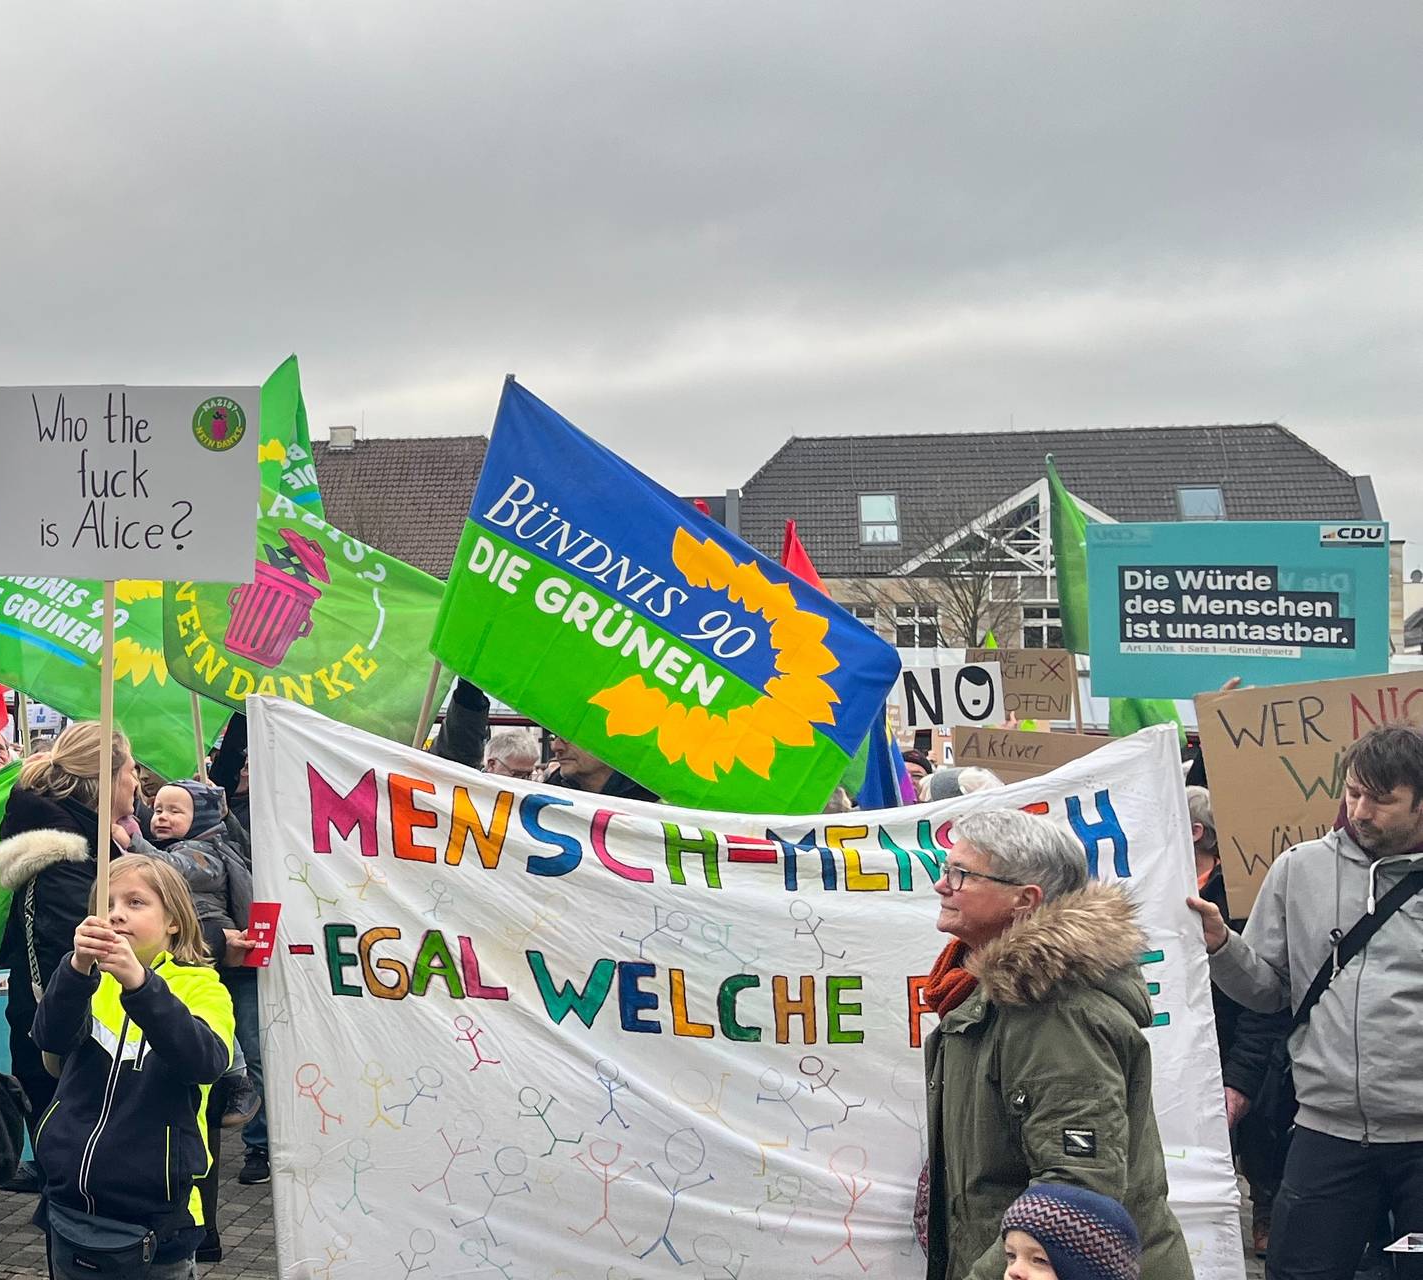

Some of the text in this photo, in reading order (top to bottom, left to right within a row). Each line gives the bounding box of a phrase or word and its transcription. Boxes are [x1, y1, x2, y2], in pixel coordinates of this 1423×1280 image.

[32, 392, 152, 443] Who the
[202, 398, 238, 412] NAZIS?
[196, 426, 242, 448] NEIN DANKE
[77, 448, 148, 498] fuck
[40, 500, 193, 550] is Alice?
[1337, 528, 1382, 539] CDU
[483, 474, 756, 659] BÜNDNIS 90
[1124, 570, 1272, 591] Die Würde
[2, 593, 104, 655] GRÜNEN
[468, 536, 725, 707] DIE GRÜNEN
[1124, 595, 1332, 618] des Menschen
[1125, 618, 1348, 644] ist unantastbar.
[225, 644, 378, 706] DANKE
[1228, 646, 1294, 656] Grundgesetz
[902, 666, 994, 726] NO
[960, 731, 1044, 760] Aktiver
[1217, 696, 1332, 749] WER
[526, 950, 864, 1045] WELCHE
